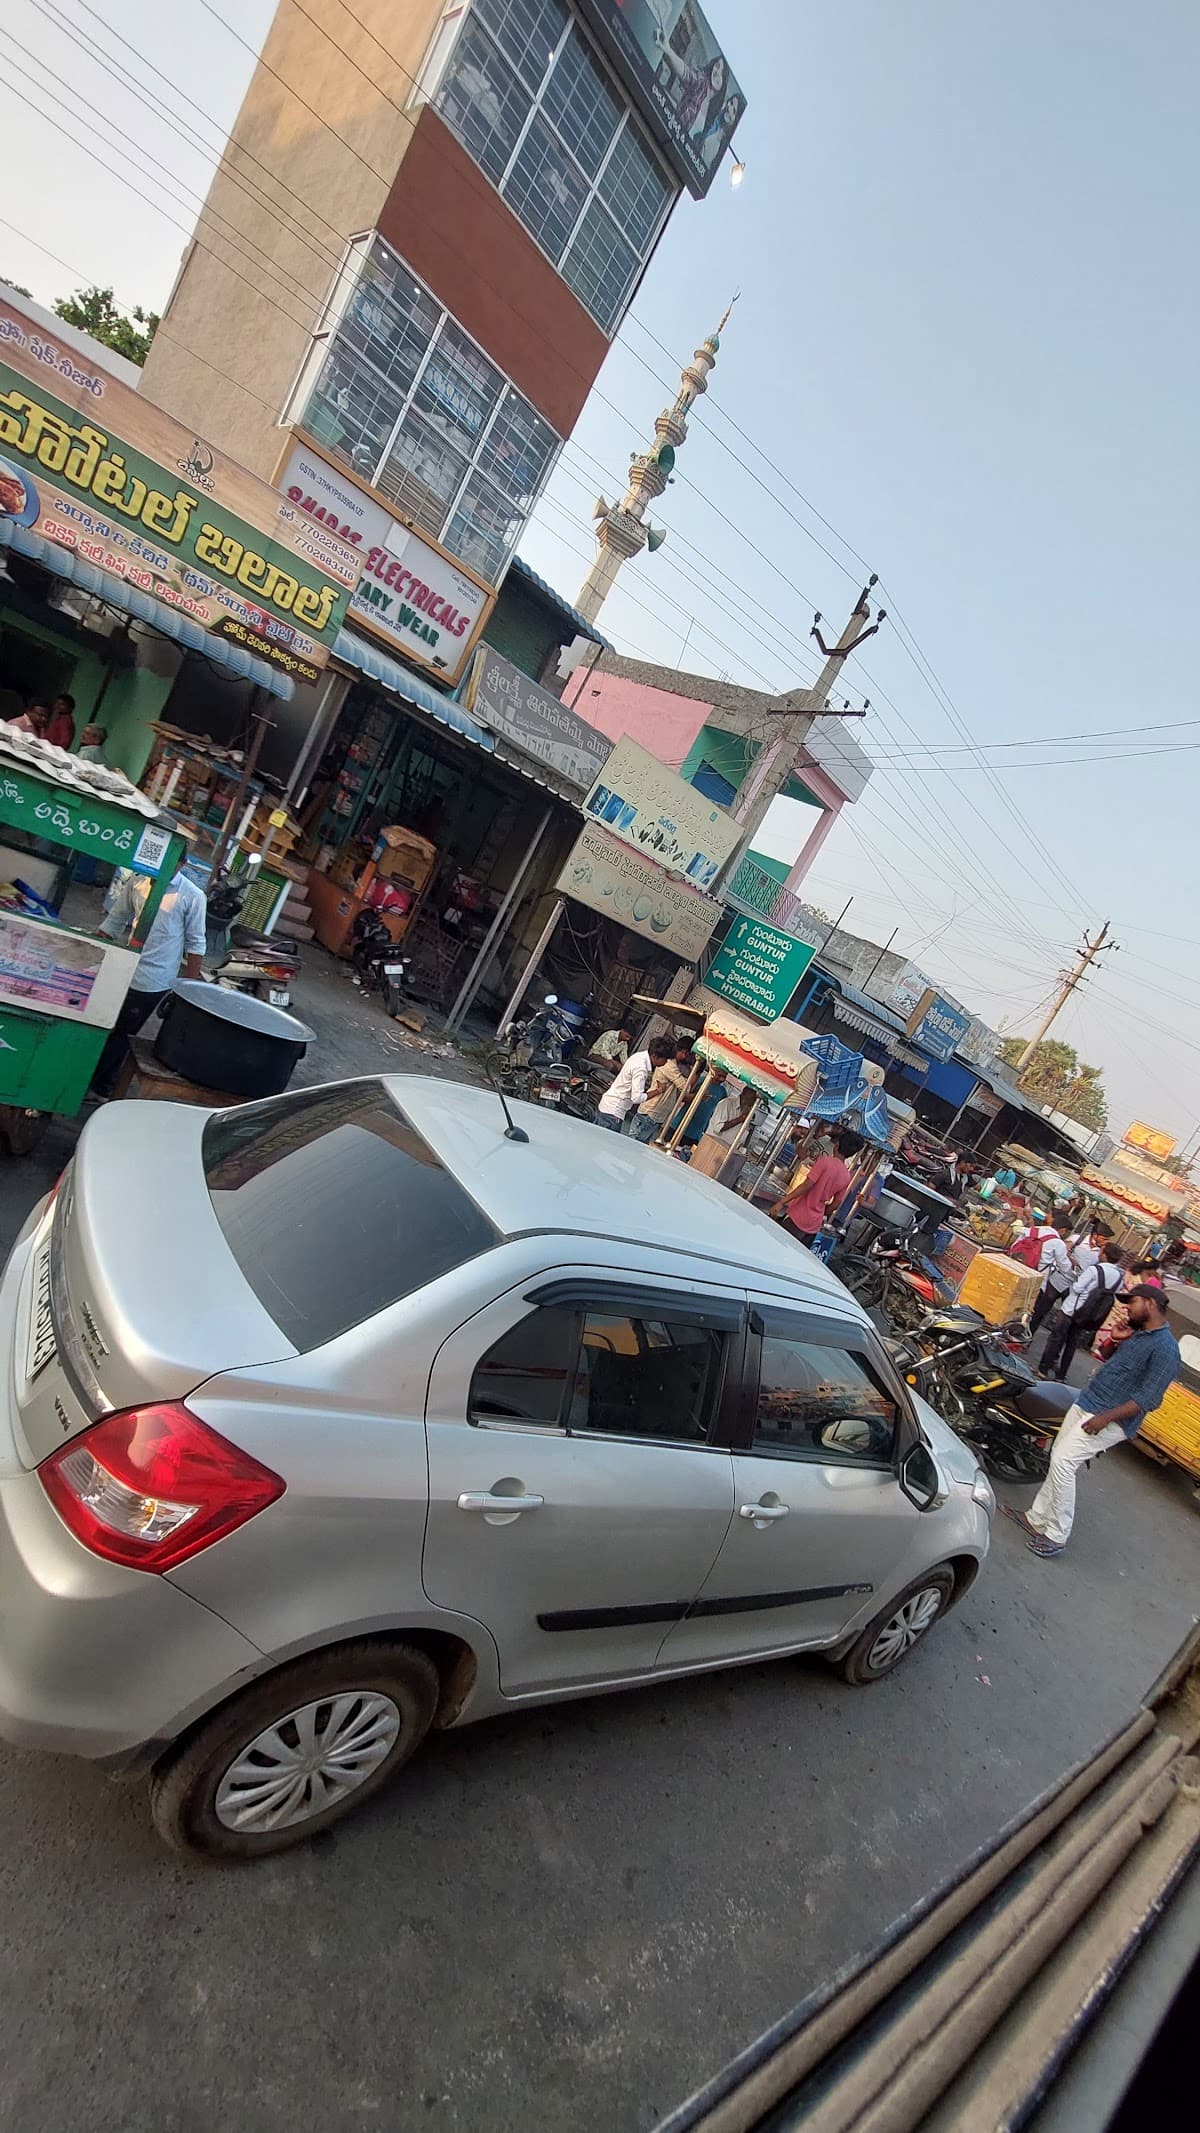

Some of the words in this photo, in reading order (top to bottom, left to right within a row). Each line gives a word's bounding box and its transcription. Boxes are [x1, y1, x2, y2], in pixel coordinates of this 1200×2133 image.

[43, 519, 78, 545] చికెన్
[54, 498, 110, 537] బిర్యాని
[294, 535, 354, 579] 7702683416
[301, 520, 359, 566] 7702283651
[198, 523, 339, 630] బిలాల్
[354, 576, 393, 611] TARY
[364, 545, 471, 637] ELECTRICALS
[35, 798, 73, 835] అద్దె
[746, 935, 786, 961] GUNTUR
[752, 926, 793, 951] గుంటూరు
[734, 958, 773, 984] GUNTUR
[740, 948, 780, 974] గుంటూరు
[720, 982, 775, 1018] HYDERABAD
[726, 969, 775, 1001] హైదరాబాదు
